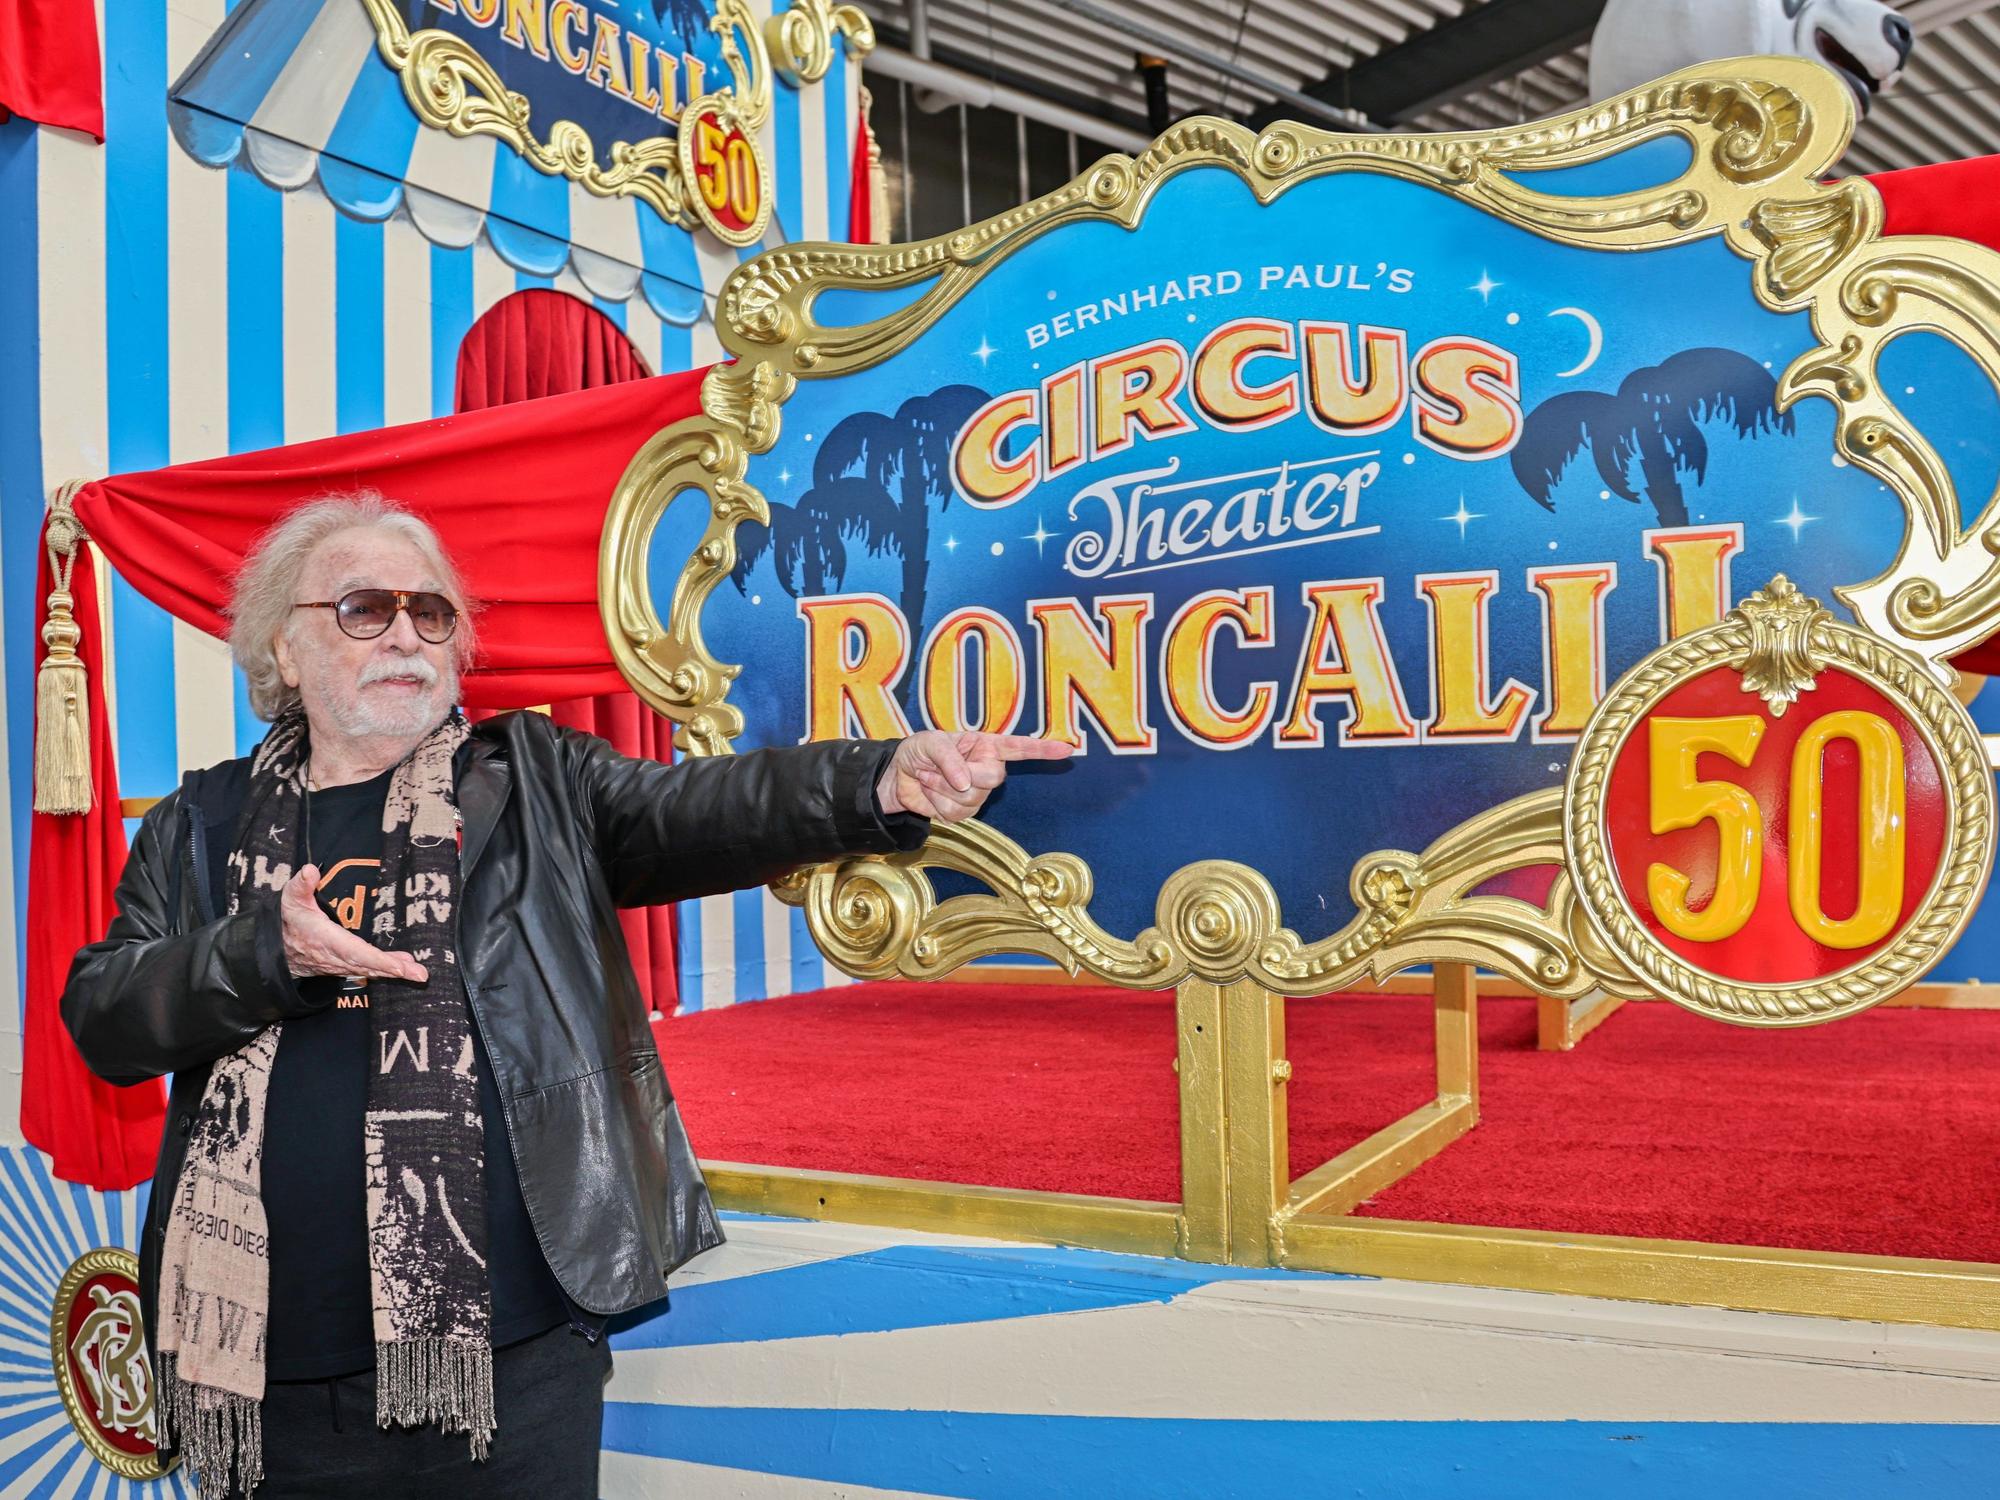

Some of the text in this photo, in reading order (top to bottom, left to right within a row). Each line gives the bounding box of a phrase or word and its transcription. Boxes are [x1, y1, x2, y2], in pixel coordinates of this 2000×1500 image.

[696, 119, 757, 223] 50
[1025, 262, 1416, 351] BERNHARD PAUL'S
[948, 316, 1524, 510] CIRCUS
[1064, 455, 1382, 578] Theater
[1647, 710, 1906, 949] 50
